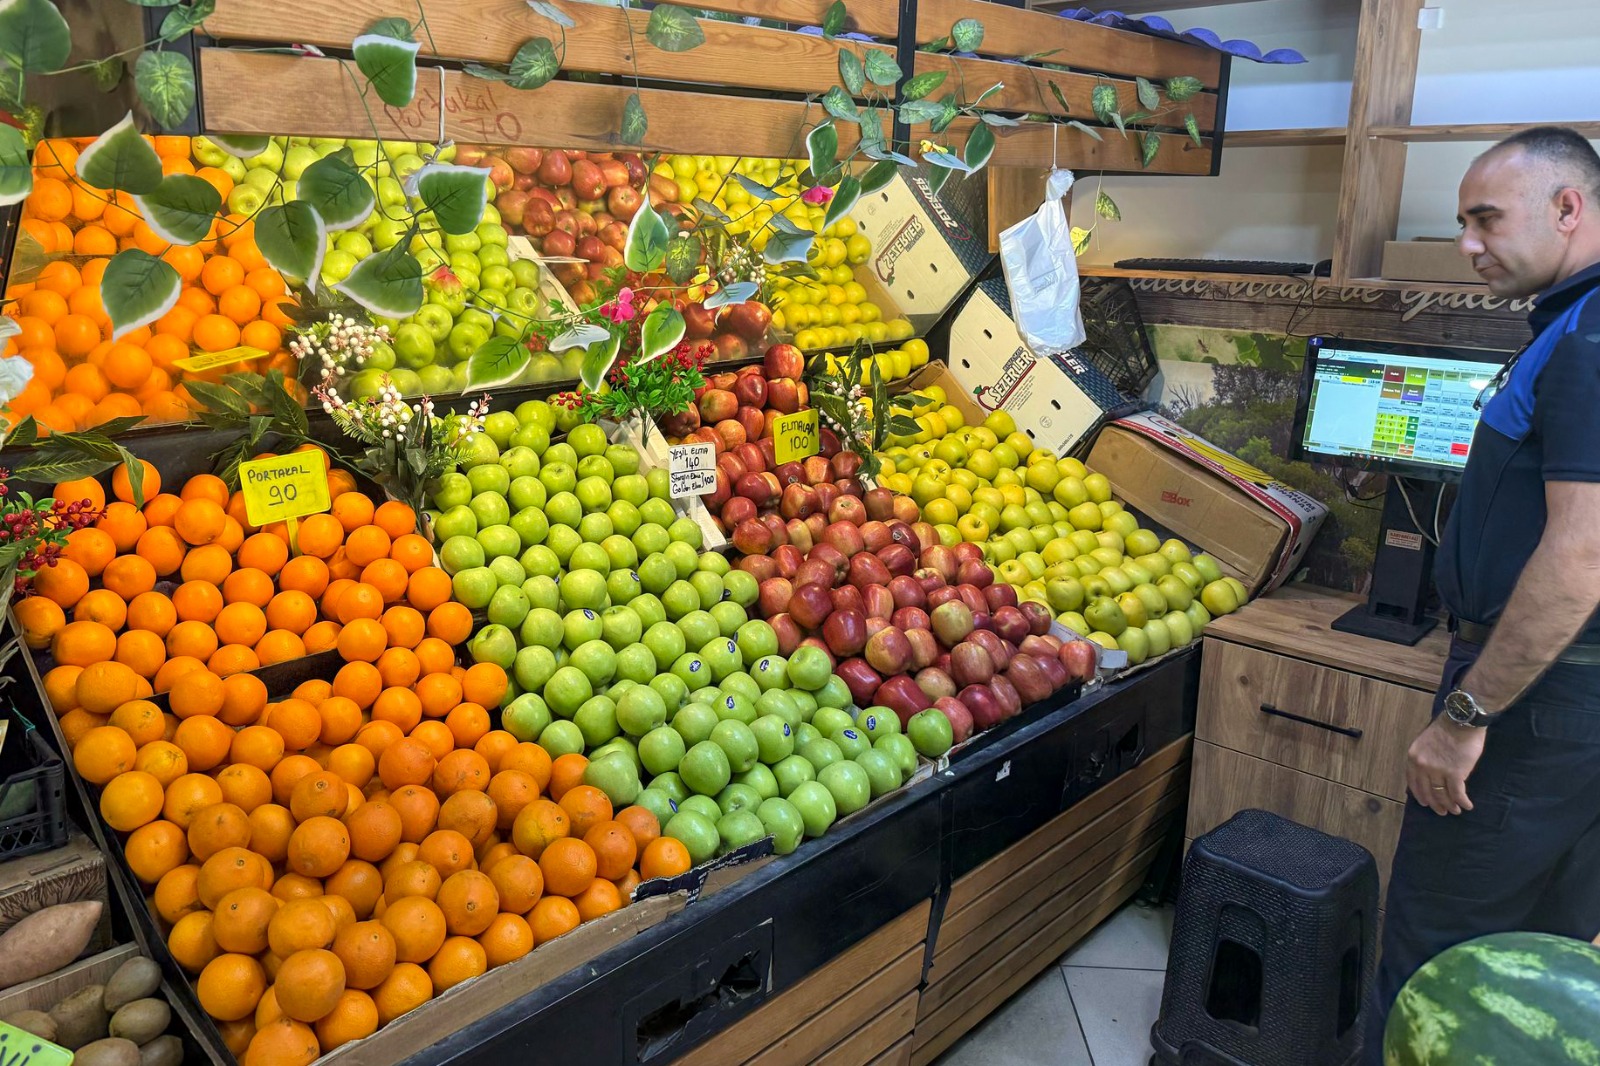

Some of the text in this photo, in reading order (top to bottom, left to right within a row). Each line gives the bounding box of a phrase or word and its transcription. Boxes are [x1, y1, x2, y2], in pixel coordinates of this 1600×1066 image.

[460, 112, 522, 142] 70
[988, 350, 1036, 402] SEZERLER
[781, 420, 815, 437] ELMALAR
[790, 436, 809, 452] 100
[685, 456, 700, 470] 140
[247, 465, 311, 484] PORTAKAL
[268, 484, 298, 507] 90
